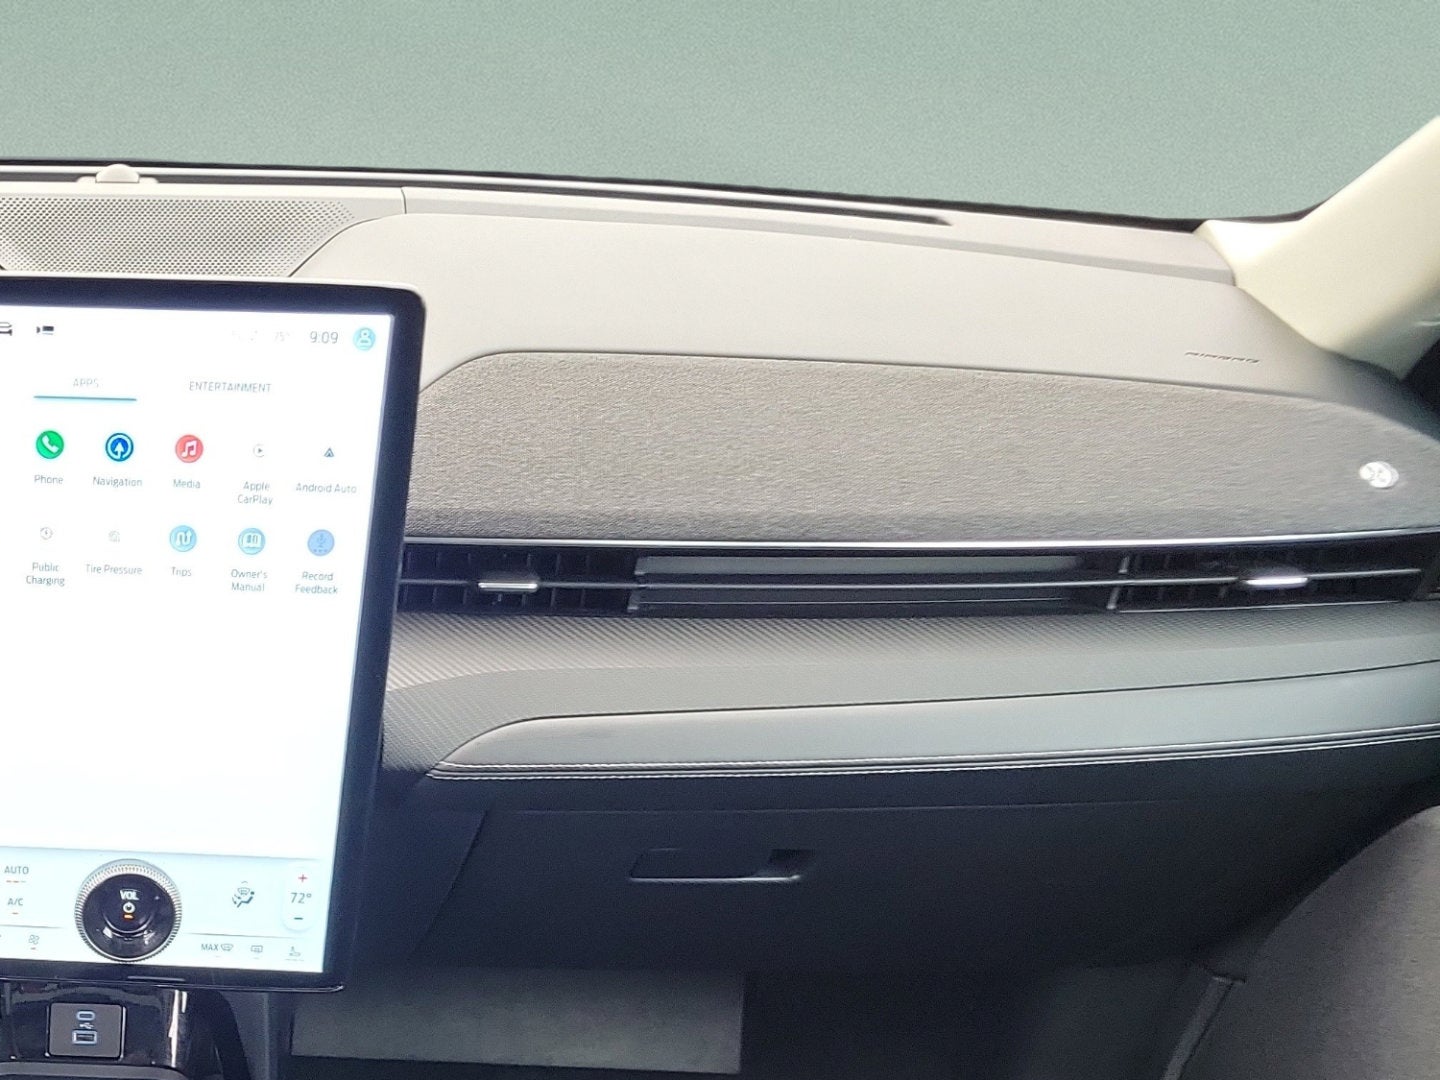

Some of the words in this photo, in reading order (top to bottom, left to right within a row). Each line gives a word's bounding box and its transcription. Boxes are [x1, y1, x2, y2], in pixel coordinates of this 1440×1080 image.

[309, 331, 339, 344] 9:09
[72, 378, 100, 388] APPS
[188, 381, 272, 394] ENTERTAINMENT
[34, 474, 64, 485] Phone
[92, 476, 143, 489] Navigation
[172, 478, 201, 489] Media
[242, 480, 270, 493] Apple
[295, 482, 332, 494] Android
[334, 483, 357, 495] Auto
[237, 494, 273, 506] CarPlay
[31, 562, 61, 573] Public
[86, 563, 102, 575] Tire
[103, 564, 143, 576] Pressure
[171, 566, 193, 578] Trips
[230, 568, 269, 580] Owner's
[301, 571, 334, 582] Record
[25, 575, 66, 588] Charging
[231, 581, 265, 593] Manual
[294, 583, 339, 595] Feedback
[4, 865, 30, 875] AUTO
[119, 889, 140, 900] VOL
[290, 892, 312, 904] 72°
[7, 897, 24, 907] A/C
[200, 943, 219, 951] MAX
